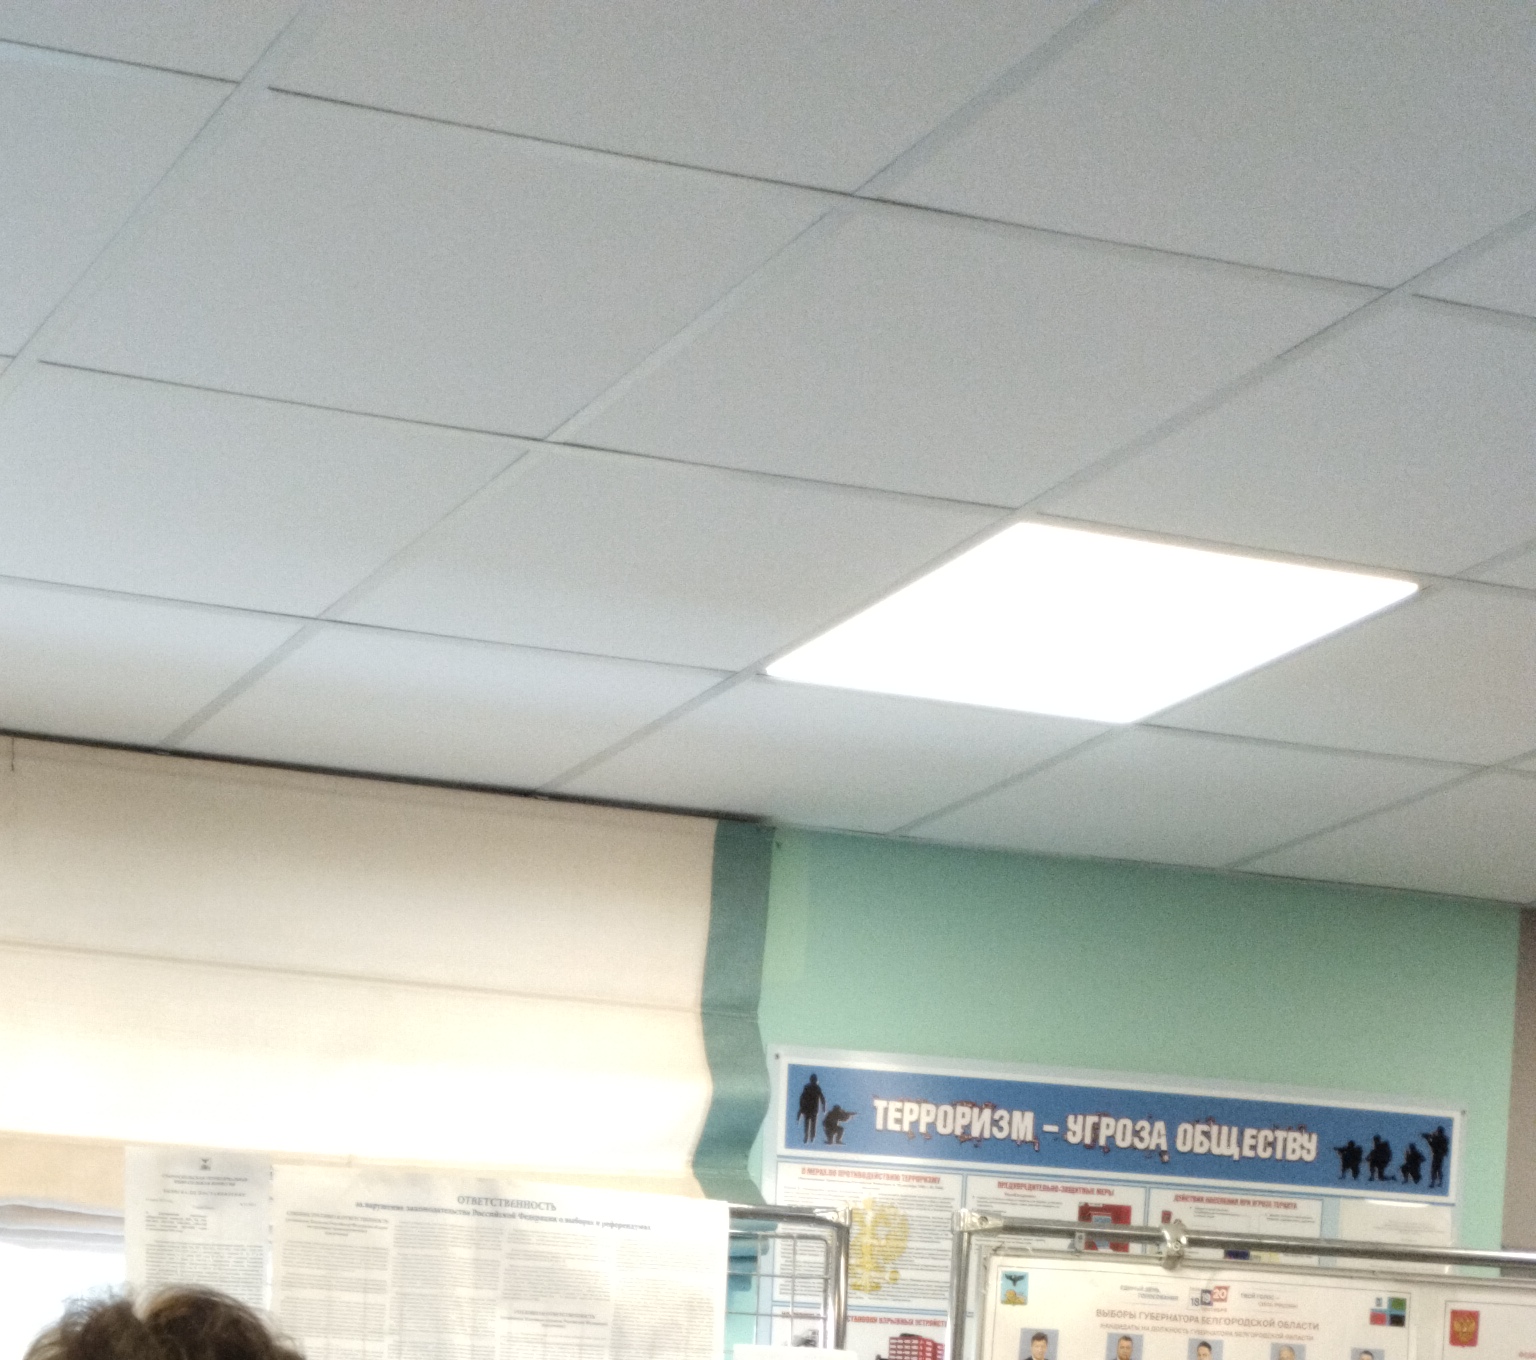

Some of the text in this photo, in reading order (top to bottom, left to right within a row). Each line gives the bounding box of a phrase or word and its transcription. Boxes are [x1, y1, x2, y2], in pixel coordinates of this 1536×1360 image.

[873, 1099, 1034, 1142] ТЕРРОРИЗМ
[1066, 1113, 1167, 1150] УГРОЗА
[1176, 1121, 1318, 1163] ОБЩЕСТВУ
[457, 1195, 556, 1212] ОТВЕТСТВЕННОСТЬ
[472, 1209, 516, 1219] Российской
[518, 1213, 557, 1223] Федерации
[1190, 1297, 1200, 1306] 18
[1213, 1288, 1227, 1299] 20
[1096, 1309, 1320, 1331] ВЫБОРЫ ГУБЕРНАТОРА БЕЛГОРОДСКОЙ ОБЛАСТИ
